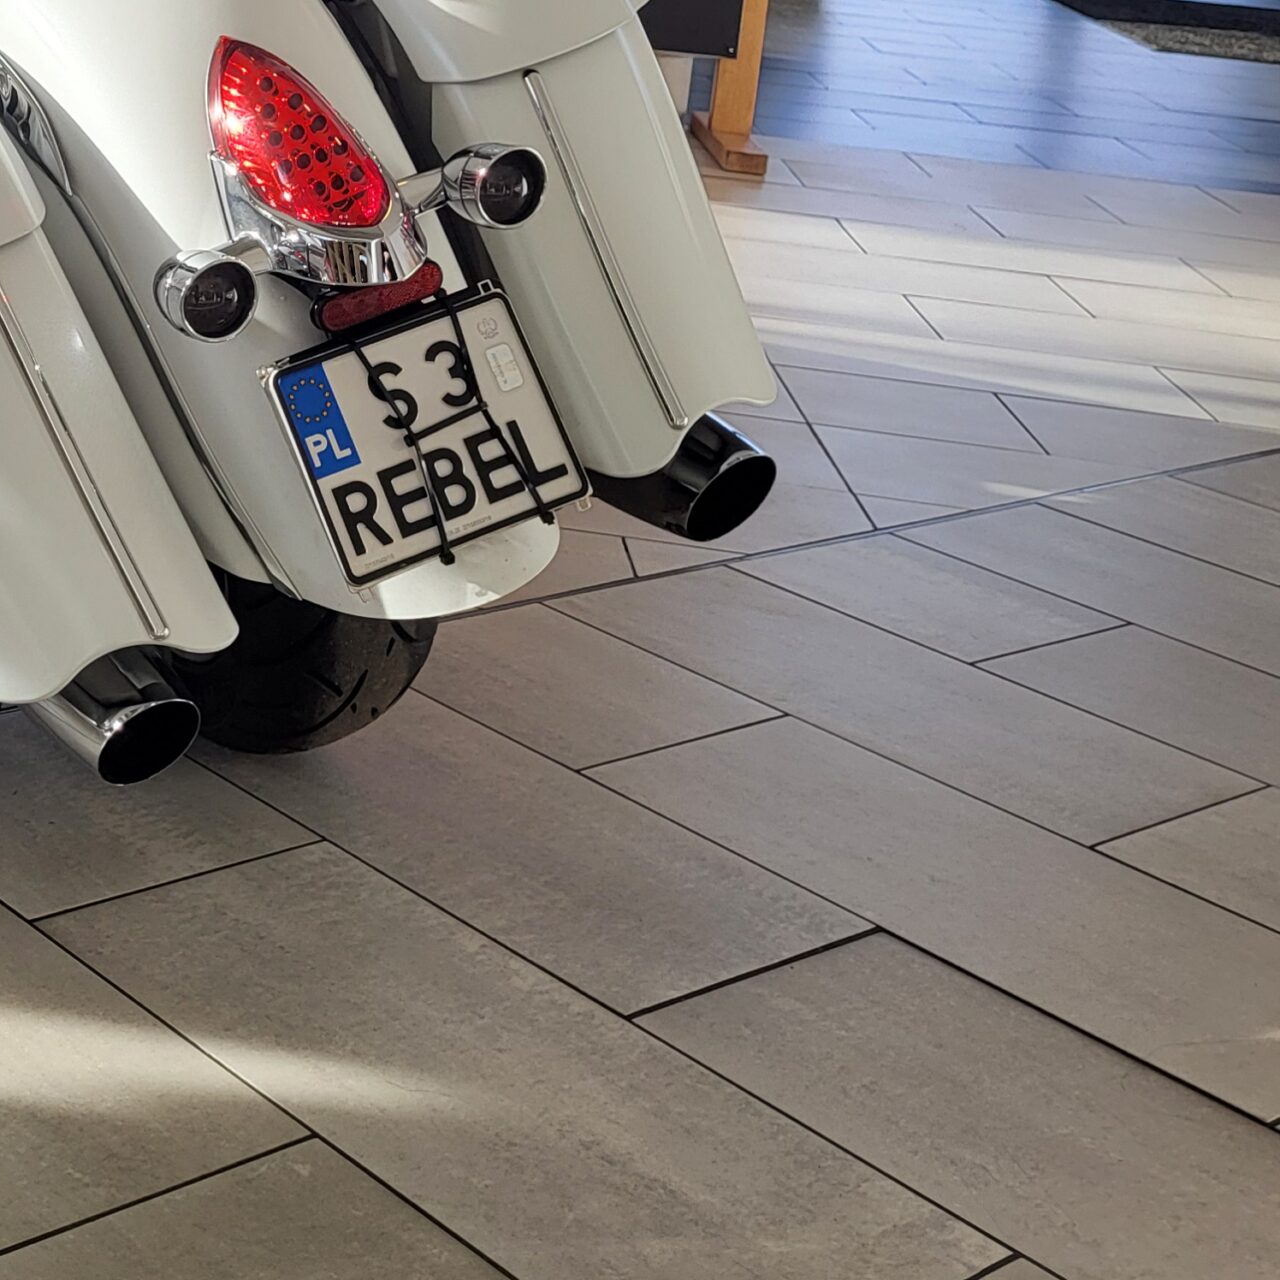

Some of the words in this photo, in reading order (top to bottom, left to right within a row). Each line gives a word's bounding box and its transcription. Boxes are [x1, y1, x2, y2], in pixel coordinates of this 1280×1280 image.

[367, 361, 418, 429] S
[424, 340, 479, 407] 3
[304, 428, 352, 468] PL
[331, 420, 569, 557] REBEL
